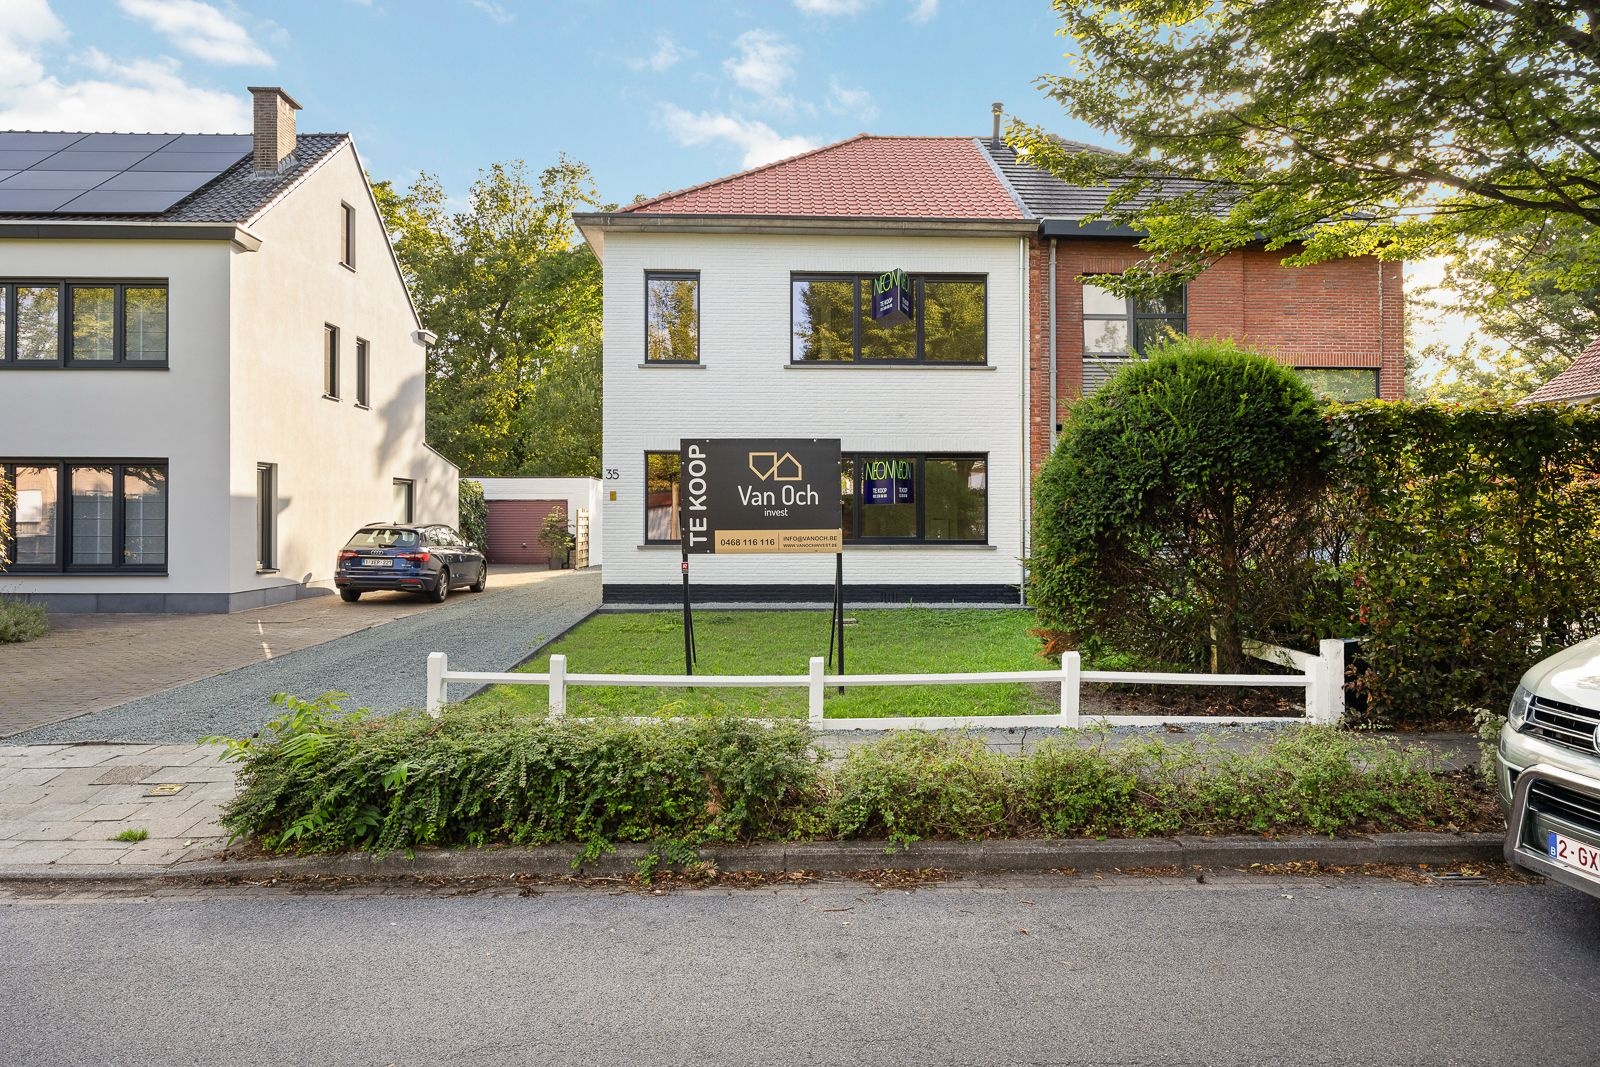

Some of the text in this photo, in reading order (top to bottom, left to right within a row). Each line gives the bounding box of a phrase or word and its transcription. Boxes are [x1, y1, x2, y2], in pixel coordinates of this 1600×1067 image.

[873, 271, 899, 297] NEON
[605, 469, 620, 480] 35
[866, 460, 895, 480] NEON
[688, 444, 708, 547] TE KOOP
[737, 484, 819, 506] Van Och
[764, 507, 788, 517] invest
[720, 538, 775, 546] 0468 116 116
[1551, 846, 1556, 855] B
[1558, 839, 1600, 872] 2-GX
